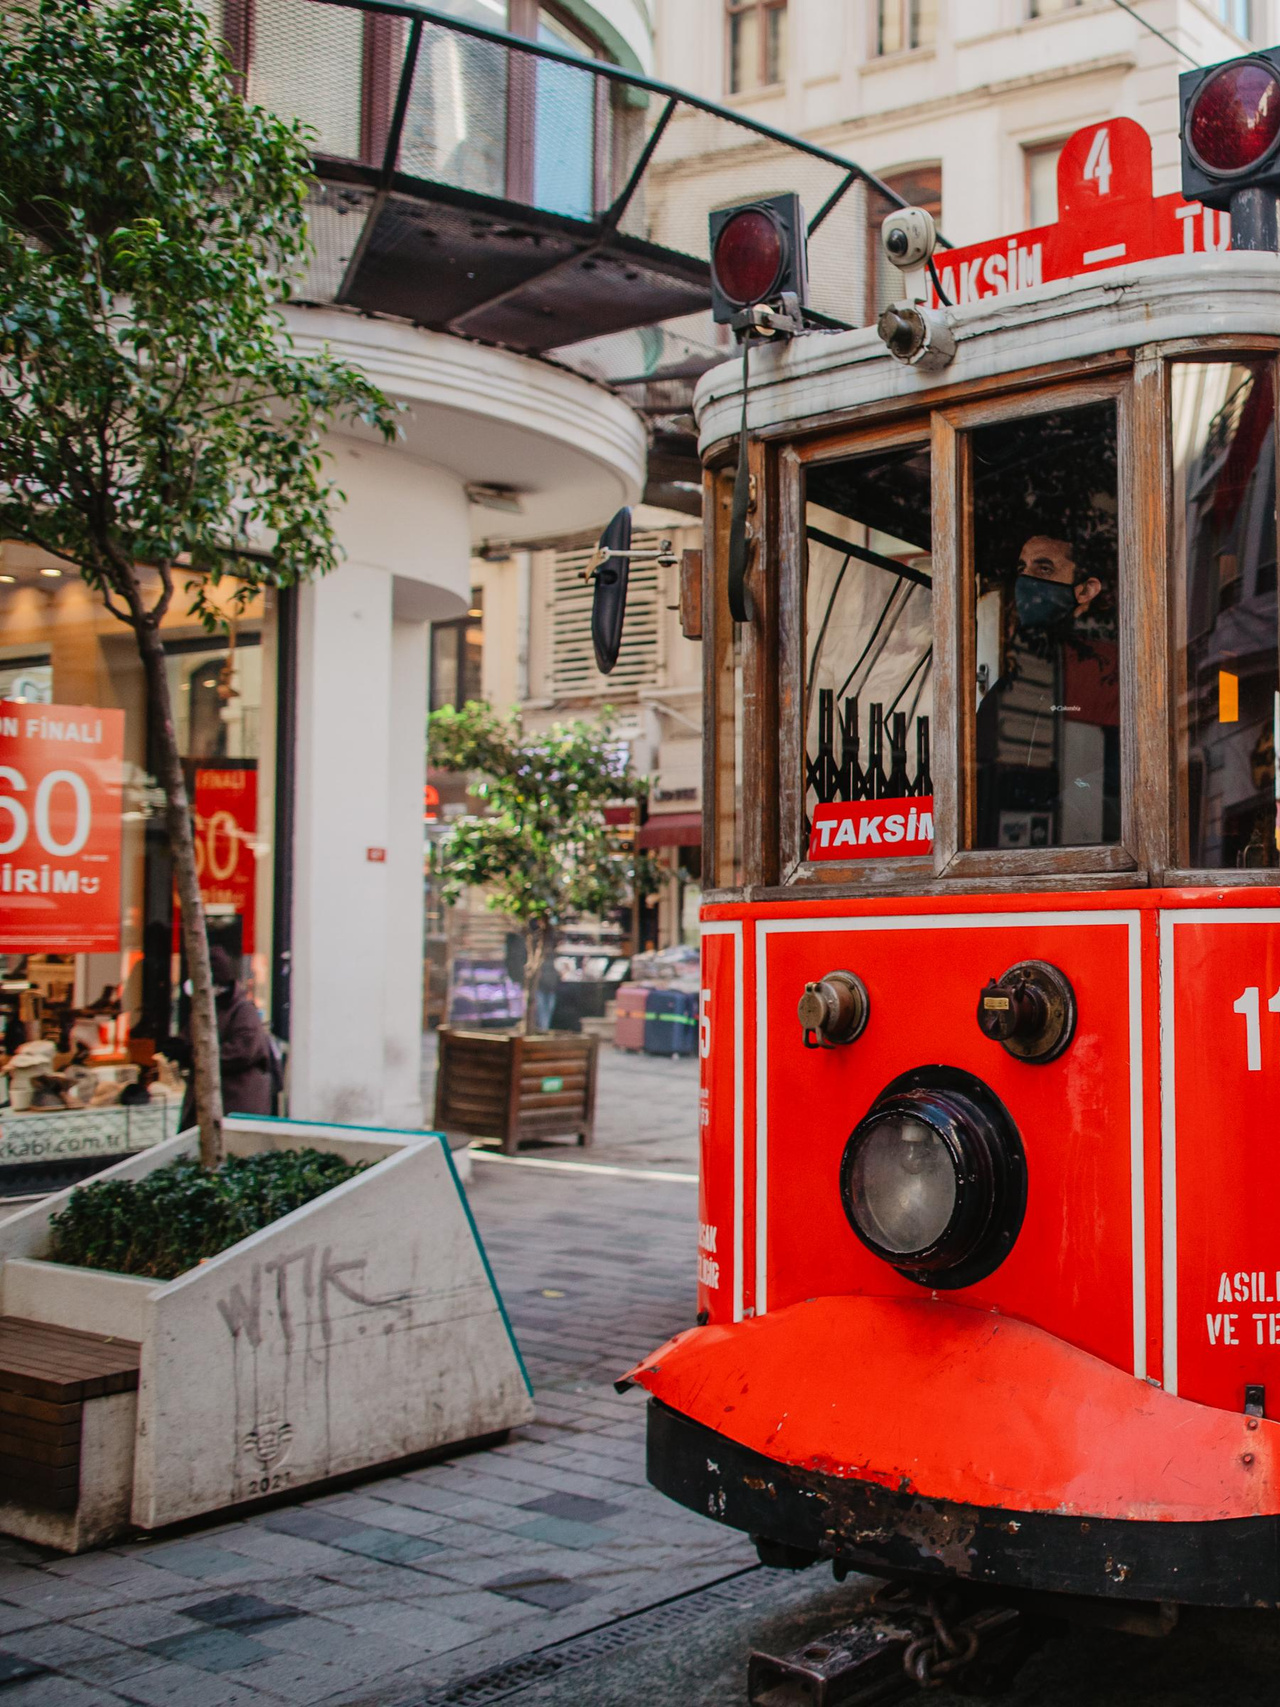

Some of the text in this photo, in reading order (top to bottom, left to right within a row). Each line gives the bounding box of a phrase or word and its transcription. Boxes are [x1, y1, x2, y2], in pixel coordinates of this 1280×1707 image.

[1083, 128, 1112, 195] 4
[26, 716, 103, 743] FİNALİ
[1206, 1313, 1240, 1345] VE
